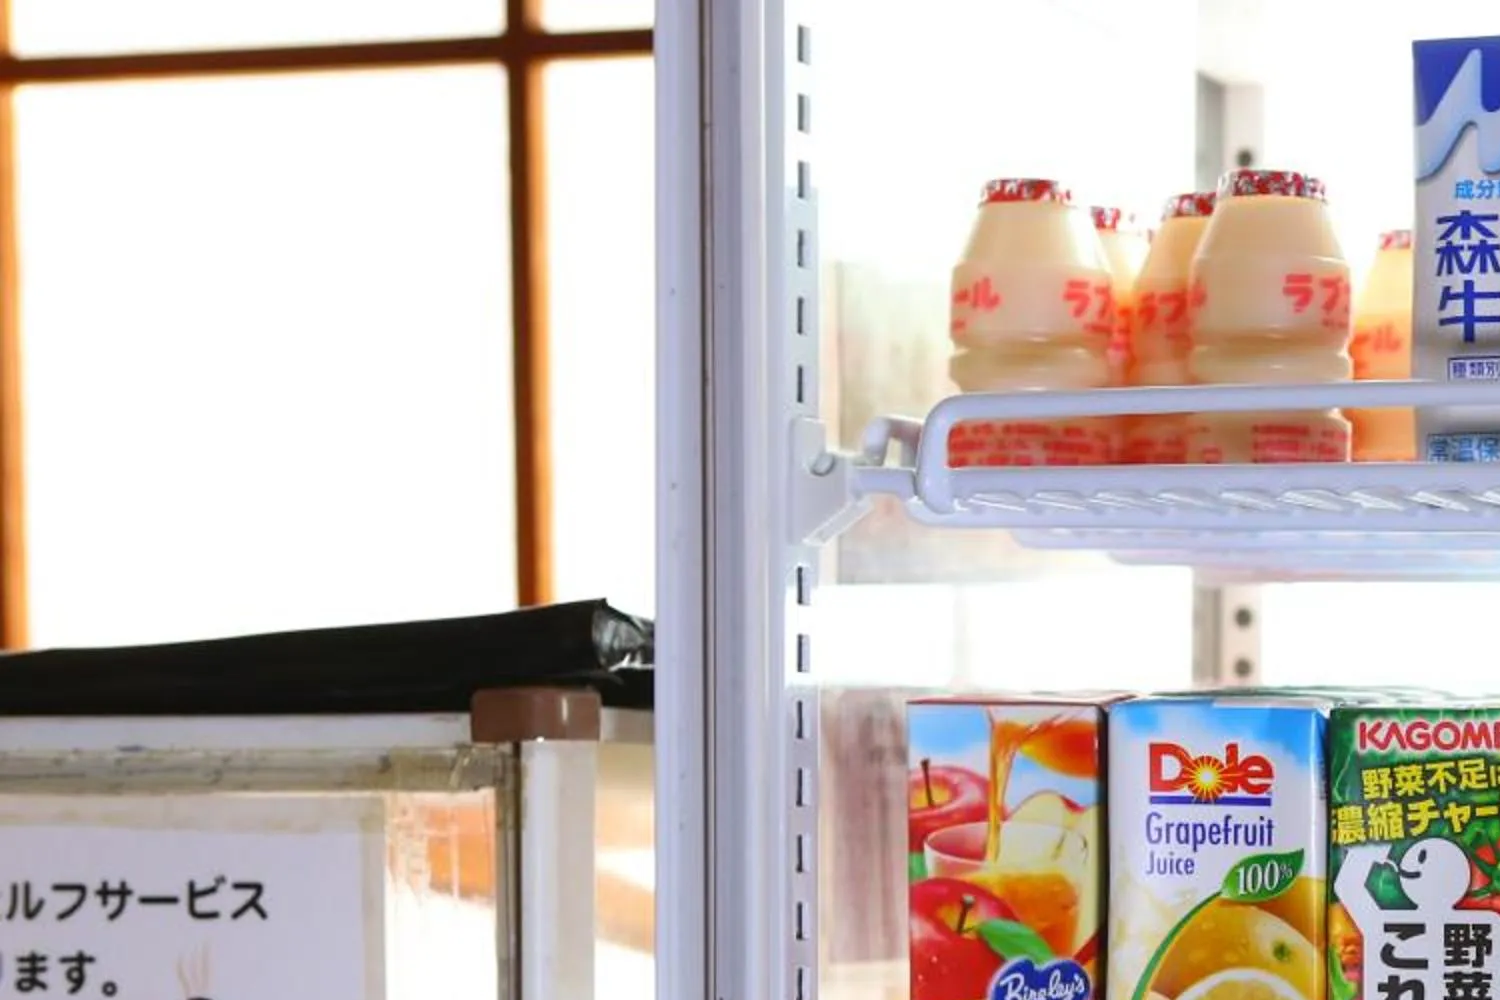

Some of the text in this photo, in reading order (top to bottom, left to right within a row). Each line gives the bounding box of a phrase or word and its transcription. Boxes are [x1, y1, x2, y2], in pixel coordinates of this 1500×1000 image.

[1149, 743, 1274, 797] Dole
[1145, 812, 1274, 851] Grapefruit
[1145, 851, 1195, 876] Juice
[1236, 861, 1296, 896] 100%
[0, 874, 268, 921] ルフサービス
[0, 950, 118, 998] ます。
